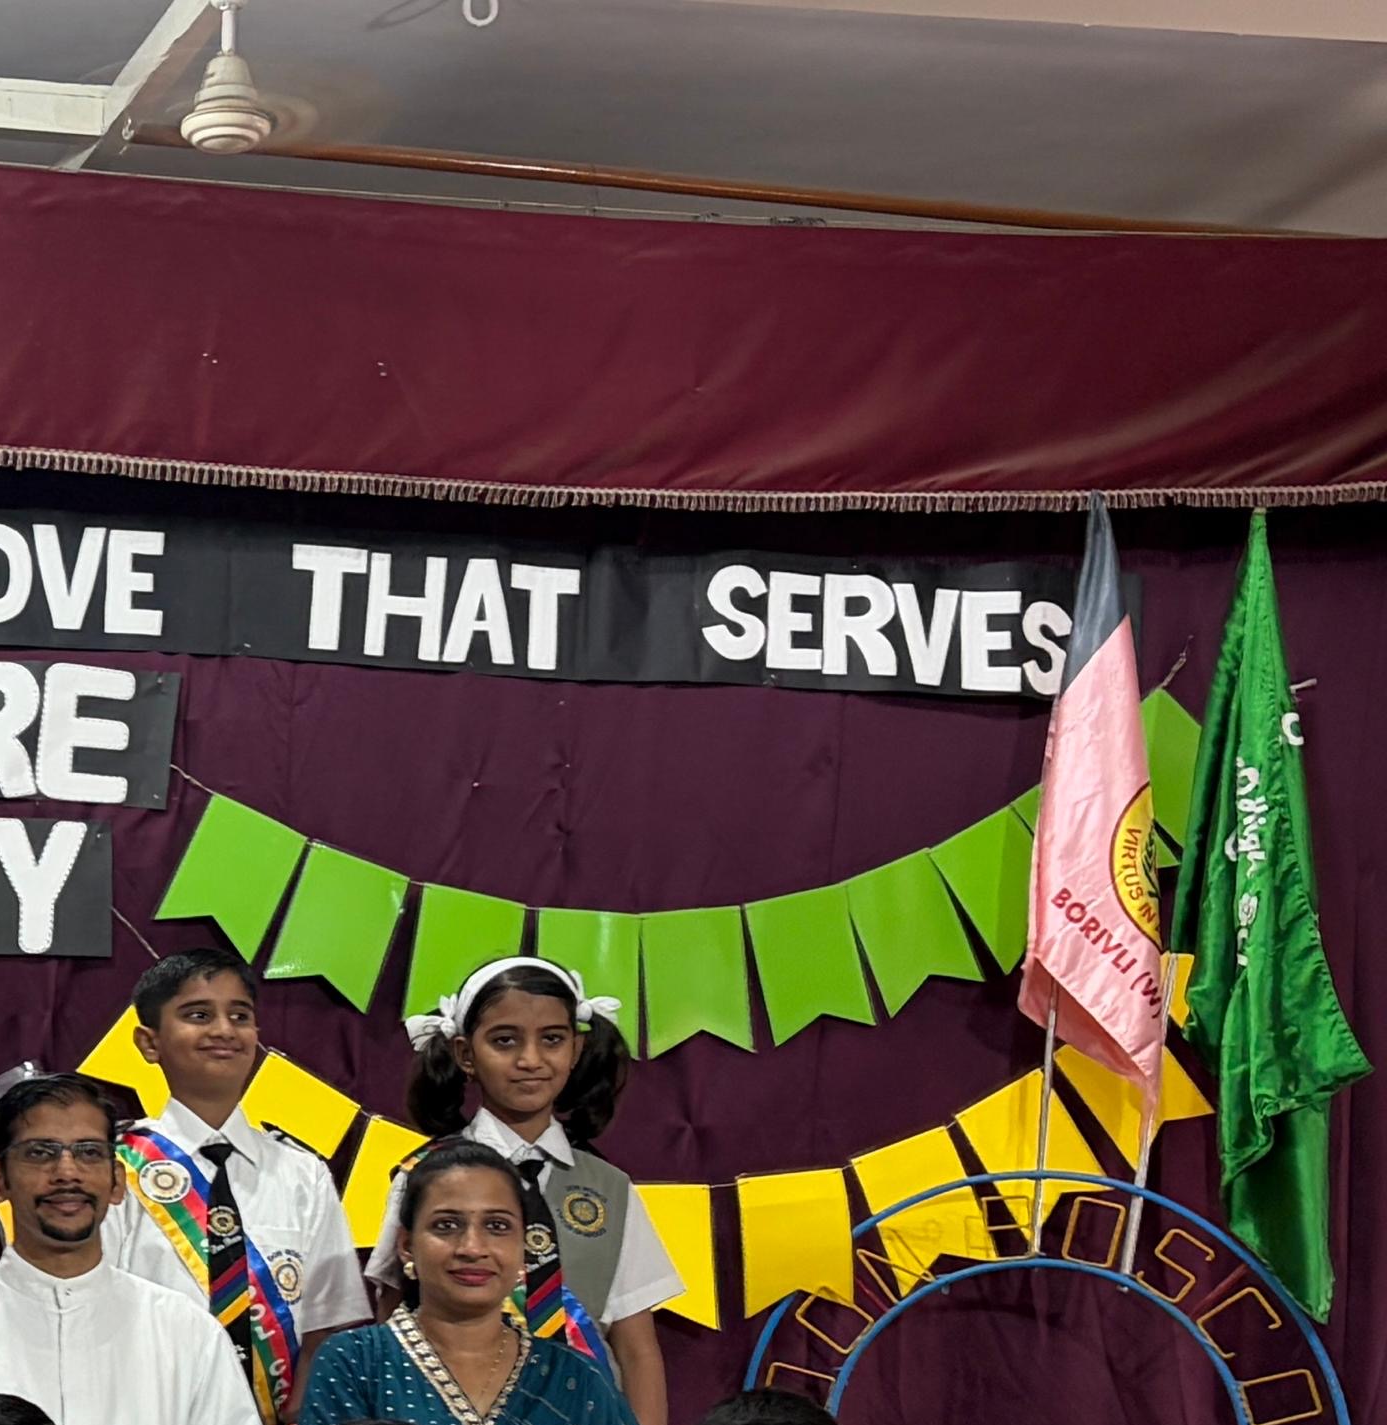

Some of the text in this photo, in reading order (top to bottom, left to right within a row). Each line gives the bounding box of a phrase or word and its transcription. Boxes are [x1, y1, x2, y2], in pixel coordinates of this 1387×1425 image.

[292, 543, 581, 671] THAT
[702, 564, 1073, 696] SERVES
[1121, 828, 1157, 924] VIRTUS IN
[1050, 887, 1138, 975] BORIVLI
